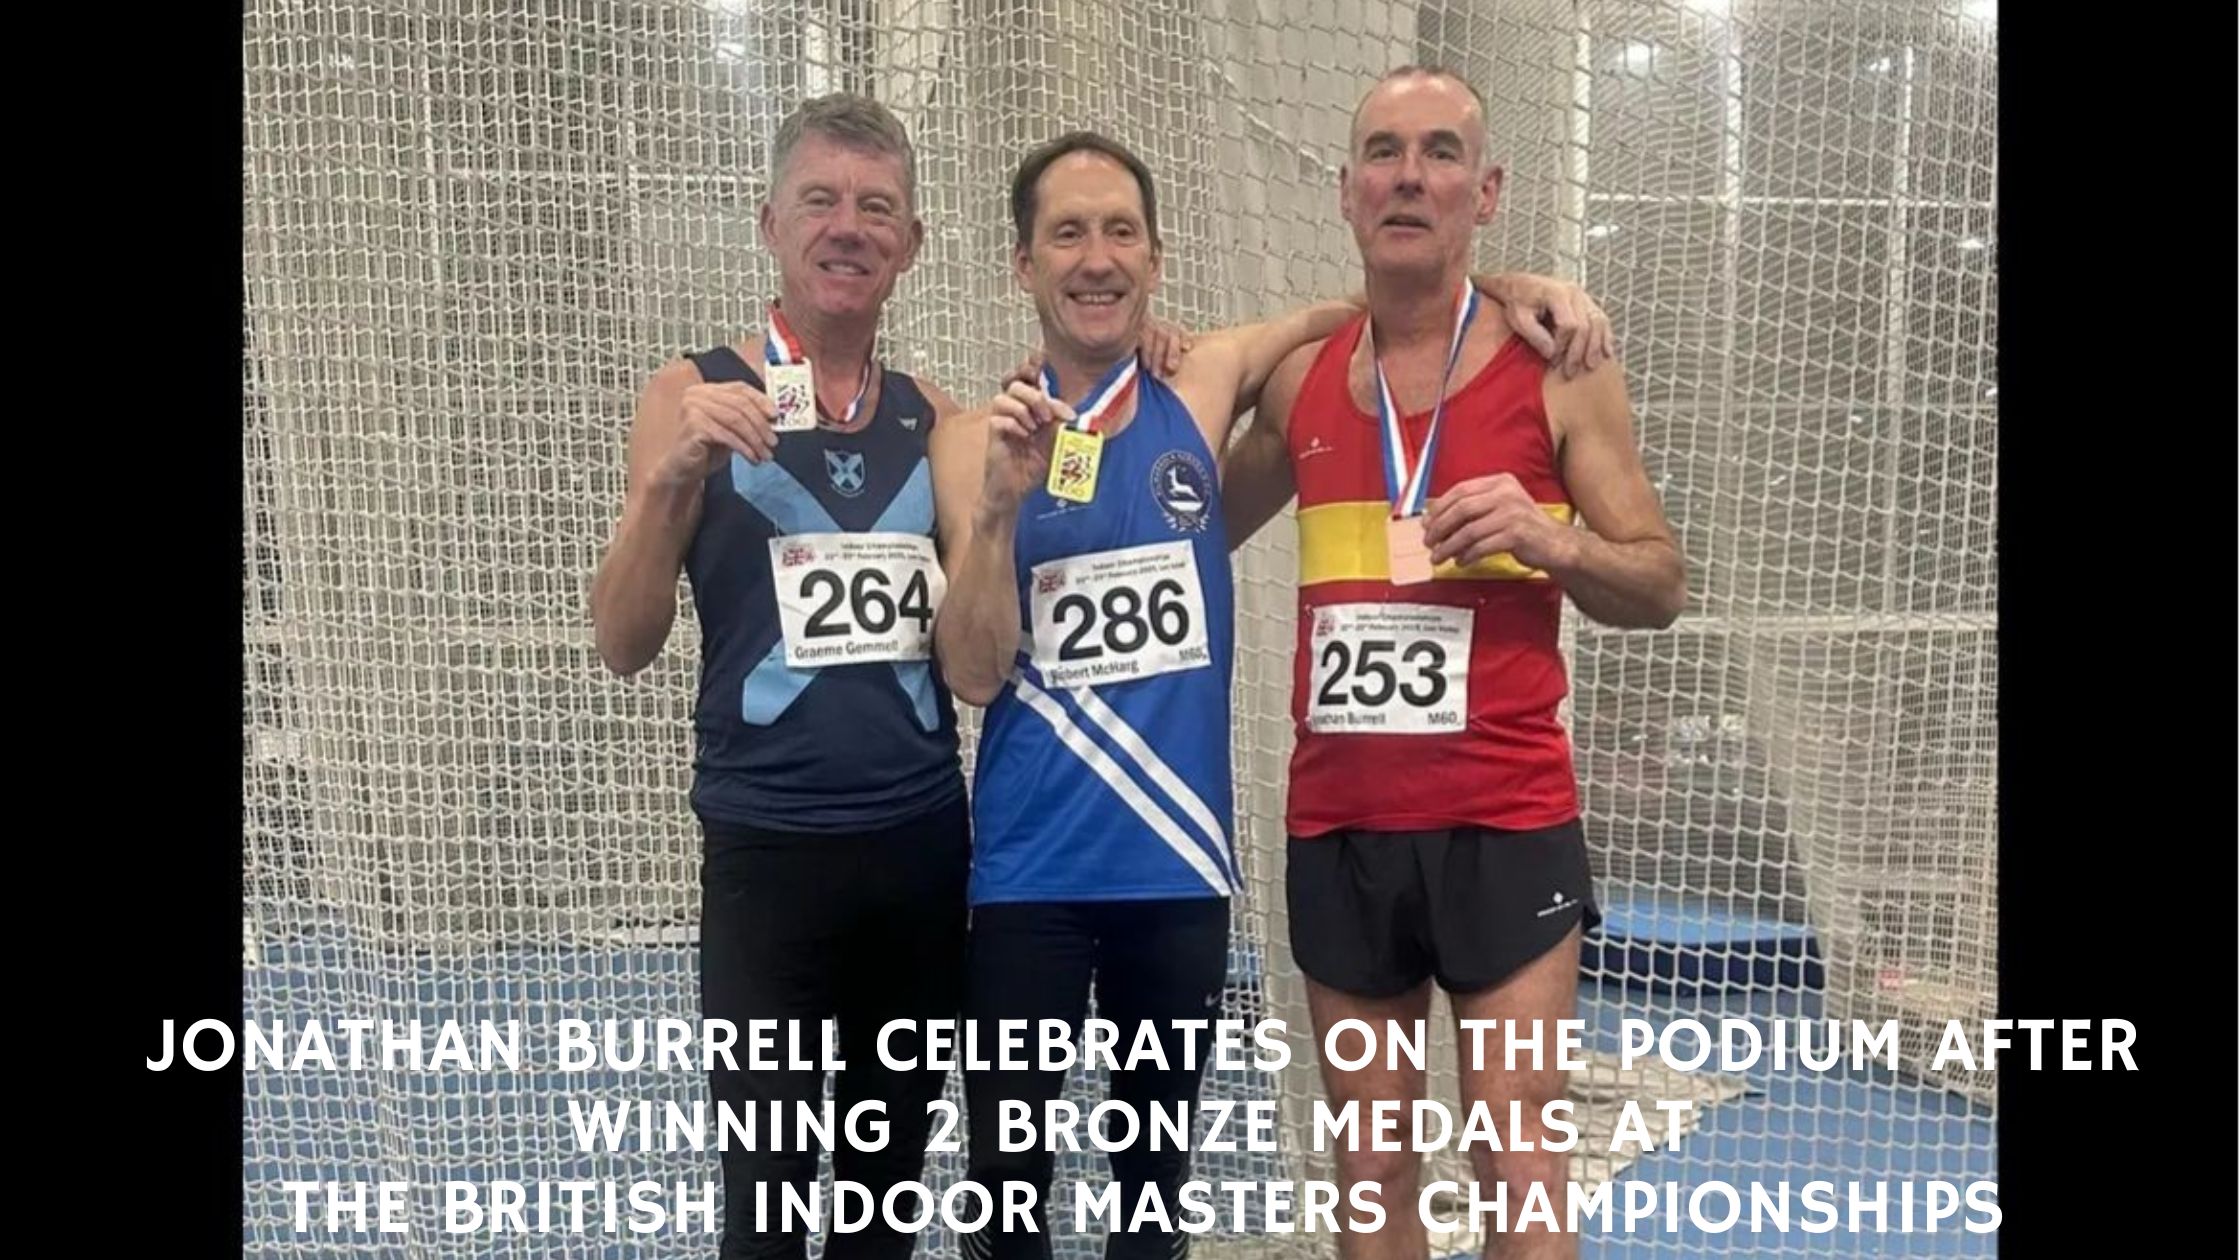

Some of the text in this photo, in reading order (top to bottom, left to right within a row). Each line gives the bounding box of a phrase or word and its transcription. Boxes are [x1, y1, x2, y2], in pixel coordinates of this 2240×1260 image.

[800, 568, 934, 638] 264
[1053, 578, 1190, 661] 286
[794, 640, 899, 659] Graeme Gemmell
[1091, 660, 1140, 678] McHarg
[1317, 640, 1447, 707] 253
[1427, 711, 1458, 725] M60
